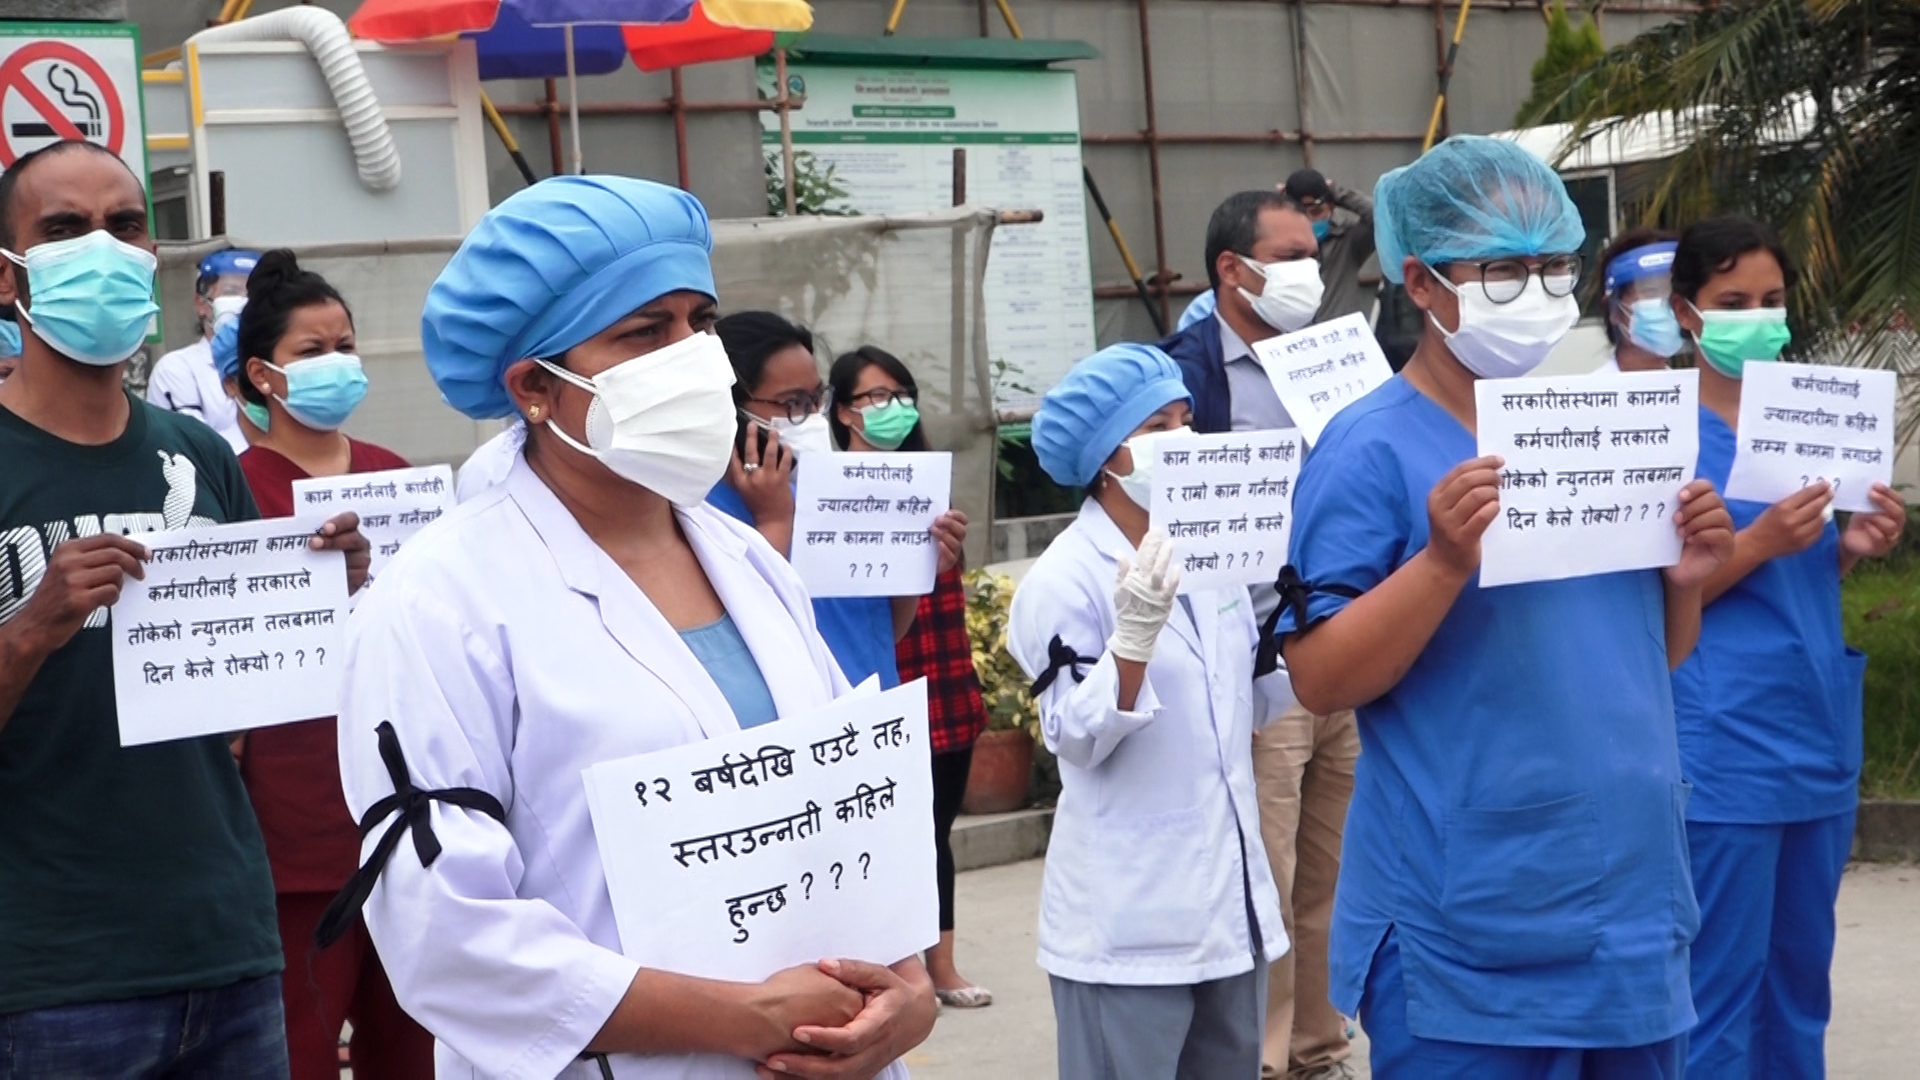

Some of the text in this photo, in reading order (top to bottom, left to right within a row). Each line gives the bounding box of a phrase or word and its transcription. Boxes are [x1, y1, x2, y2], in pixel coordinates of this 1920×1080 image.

[1502, 388, 1618, 410] सरकारीसंस्थामा
[1845, 412, 1878, 431] कहिले
[1514, 424, 1671, 451] कर्मचारीलाई सरकारले
[1752, 439, 1787, 453] सम्म
[1795, 443, 1835, 457] काममा
[1163, 451, 1191, 465] काम
[843, 462, 913, 483] कर्मचारीलाई
[1557, 470, 1615, 496] न्युनतम
[1623, 467, 1685, 485] तलबमान
[305, 490, 332, 503] काम
[1167, 487, 1175, 502] र
[1215, 484, 1241, 498] काम
[818, 495, 933, 514] ज्यालदारीमा कहिले
[363, 515, 391, 527] काम
[1507, 507, 1537, 530] दिन
[1547, 506, 1573, 525] केले
[807, 531, 837, 545] सम्म
[844, 531, 885, 543] काममा
[148, 568, 311, 601] कर्मचारीलाई सरकारले
[128, 609, 335, 646] तोकेको न्युनतम तलबमान
[144, 662, 175, 683] दिन
[184, 657, 215, 679] केले
[635, 778, 671, 807] १२
[691, 745, 795, 793] बर्षदेखि
[810, 722, 859, 766] एउटै
[670, 776, 897, 867] स्तरउन्नती कहिले
[725, 884, 787, 943] हुन्छ
